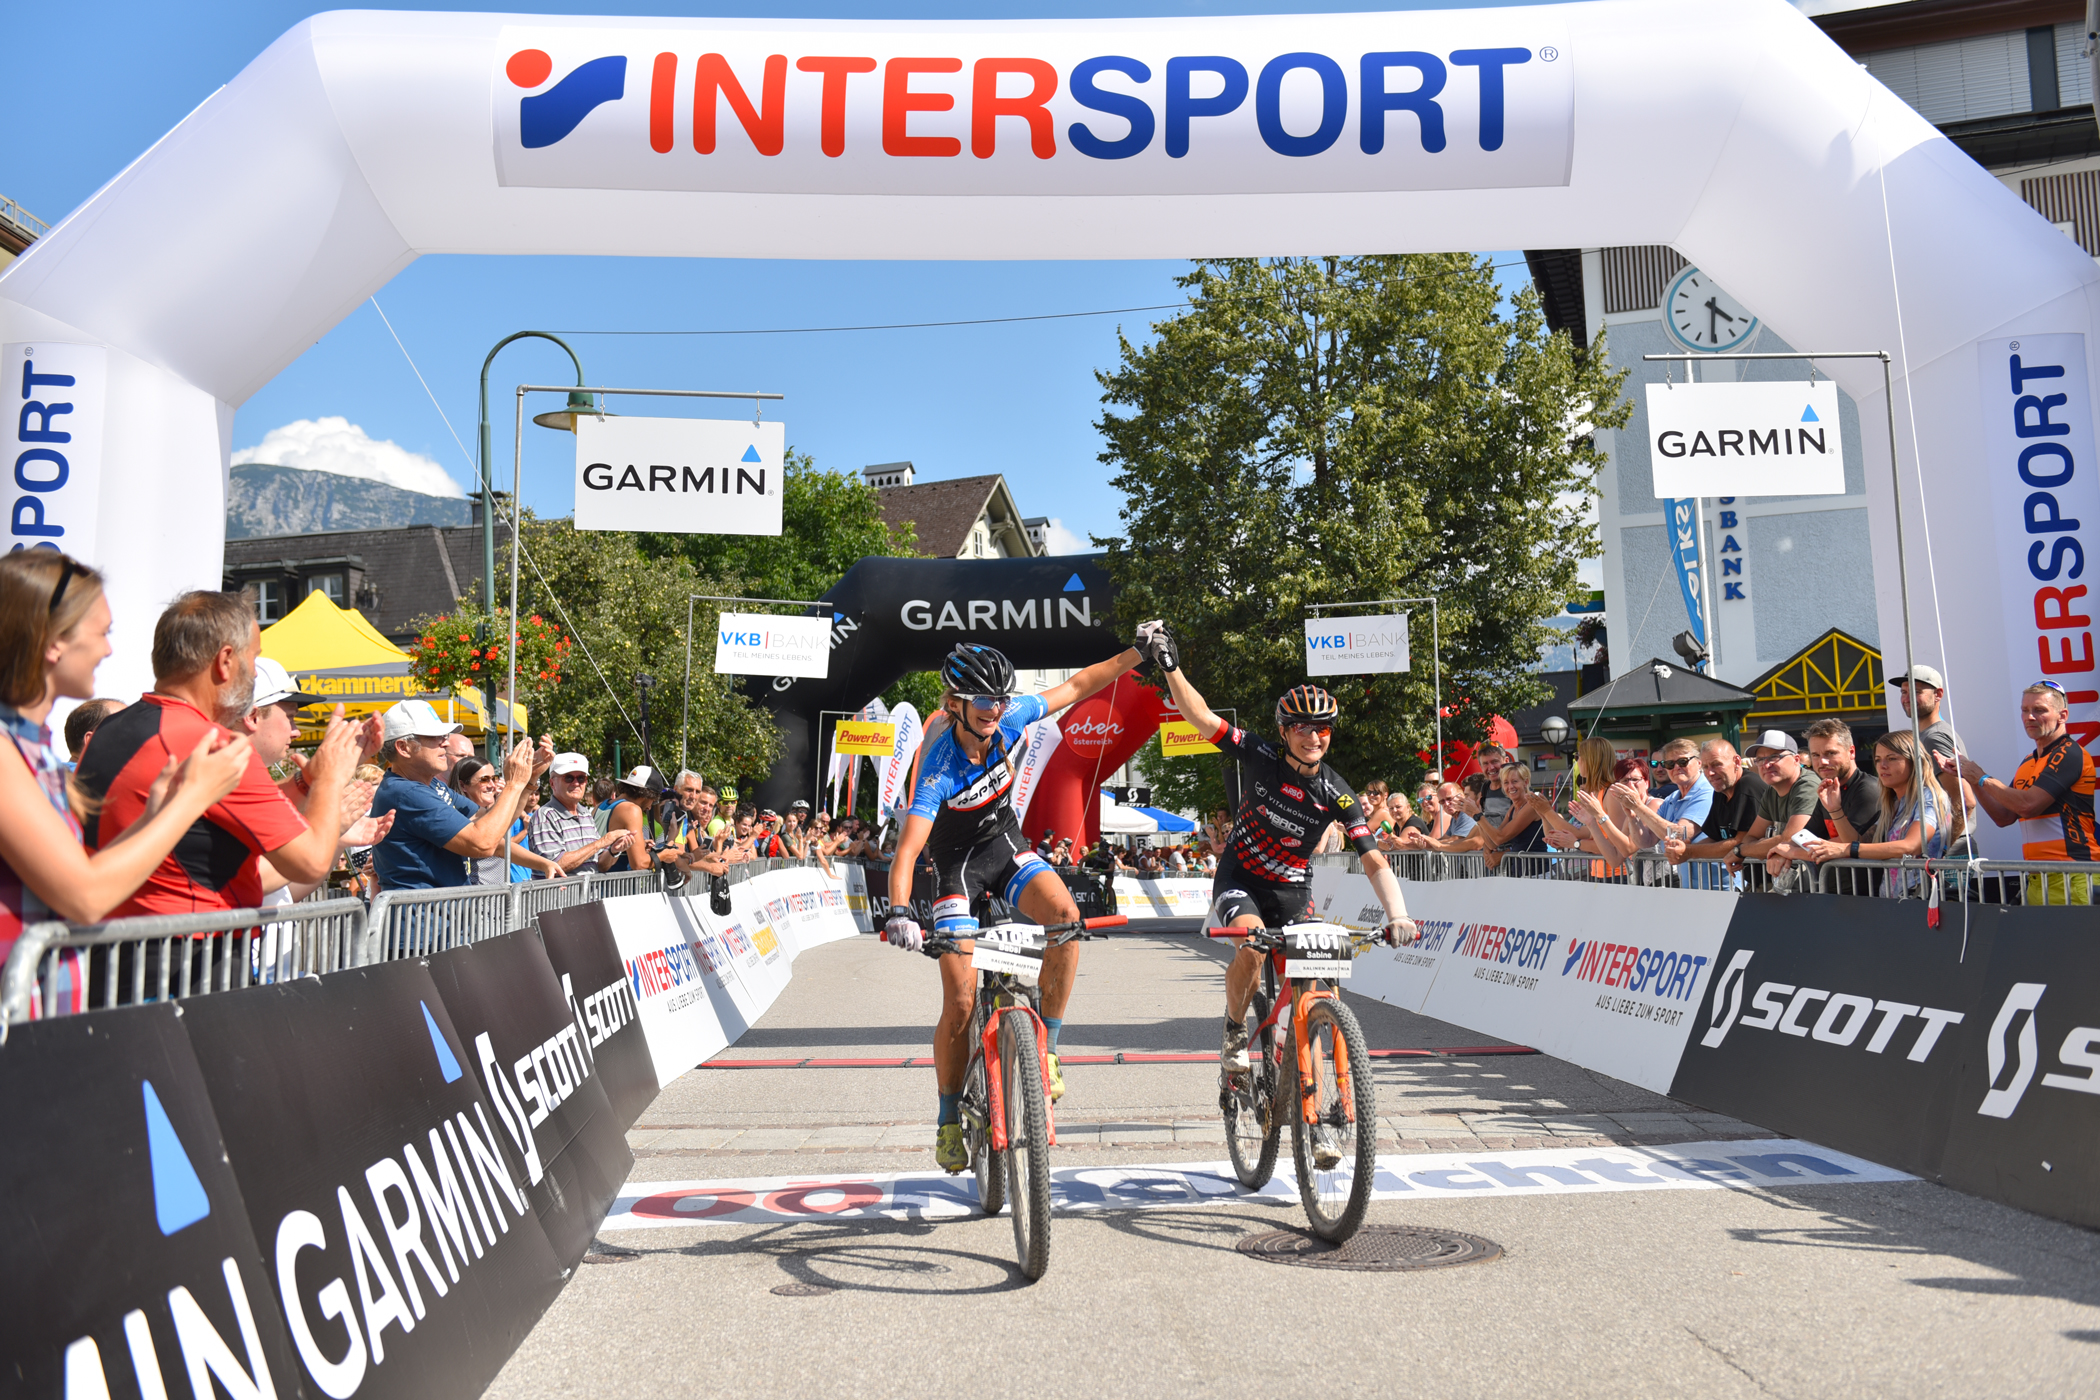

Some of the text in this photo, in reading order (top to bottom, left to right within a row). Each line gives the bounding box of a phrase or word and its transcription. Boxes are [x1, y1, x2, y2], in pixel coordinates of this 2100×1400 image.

[649, 47, 1532, 159] INTERSPORT
[1657, 428, 1826, 458] GARMIN
[583, 463, 765, 495] GARMIN
[901, 596, 1091, 630] GARMIN
[720, 631, 828, 650] VKB BANK
[733, 651, 749, 659] TEIL
[751, 652, 780, 661] MEINES
[1307, 630, 1407, 650] VKB BANK
[1321, 652, 1336, 661] TEIL
[1337, 651, 1365, 661] MEINES
[839, 730, 891, 745] PowerBar
[1065, 715, 1125, 735] ober
[883, 712, 913, 804] INTERSPORT
[1073, 738, 1113, 746] österreich
[1016, 723, 1048, 807] INTERSPORT
[1256, 804, 1305, 837] AMBROS
[1268, 796, 1320, 826] VITALMONITOR
[984, 929, 1035, 947] A105
[1295, 933, 1340, 950] A101
[1461, 922, 1557, 971] INTERSPORT
[636, 943, 699, 998] INTERSPORT
[1306, 951, 1333, 959] Sabine
[1576, 939, 1708, 1002] INTERSPORT
[1473, 966, 1539, 991] AUS LIEBE ZUM SPORT
[584, 976, 634, 1049] SCOTT
[1595, 993, 1684, 1027] AUS LIEBE ZUM SPORT
[1740, 980, 1965, 1063] SCOTT
[513, 1020, 595, 1130] SCOTT
[275, 1101, 527, 1400] GARMIN
